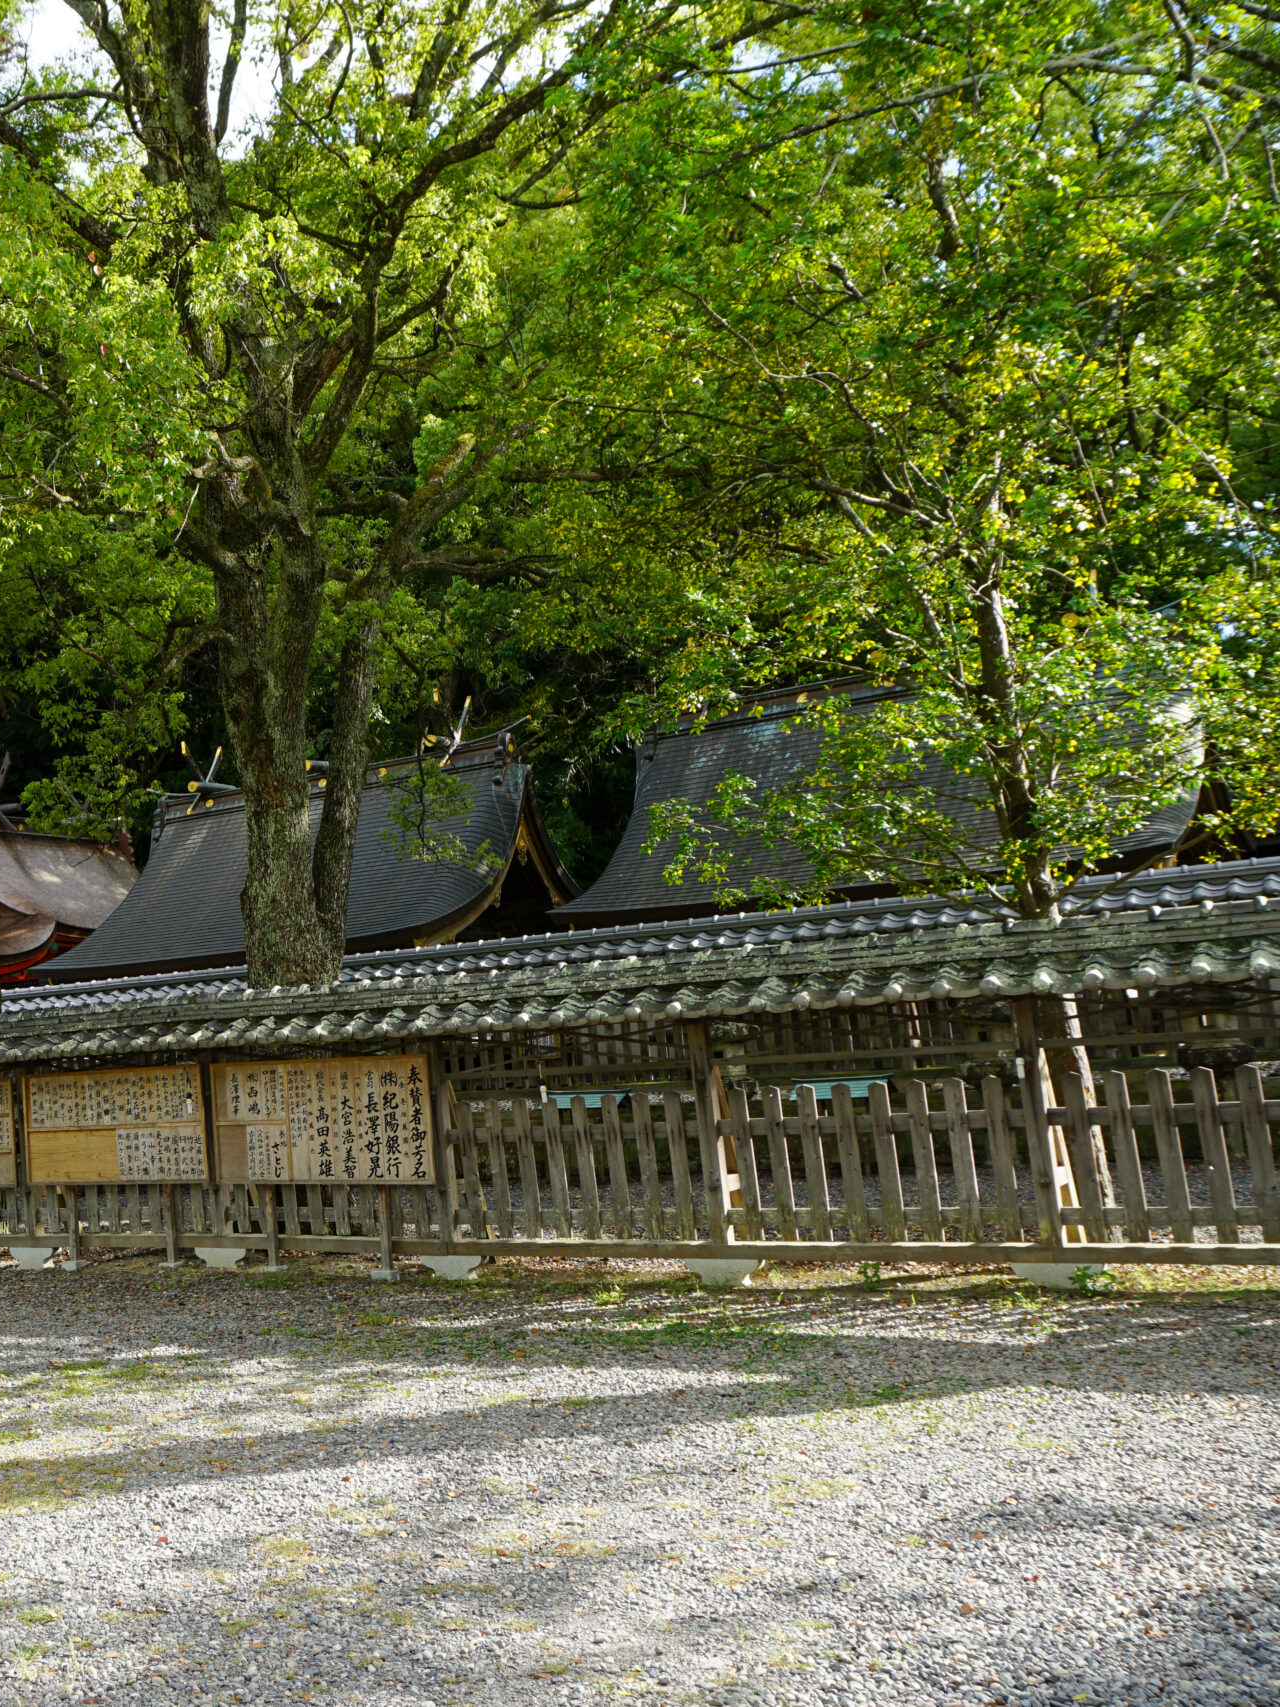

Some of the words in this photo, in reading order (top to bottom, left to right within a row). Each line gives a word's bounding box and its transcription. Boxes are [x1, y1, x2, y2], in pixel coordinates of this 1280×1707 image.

[407, 1064, 427, 1179] 奉賛者御芳名
[272, 1142, 284, 1178] さとじ
